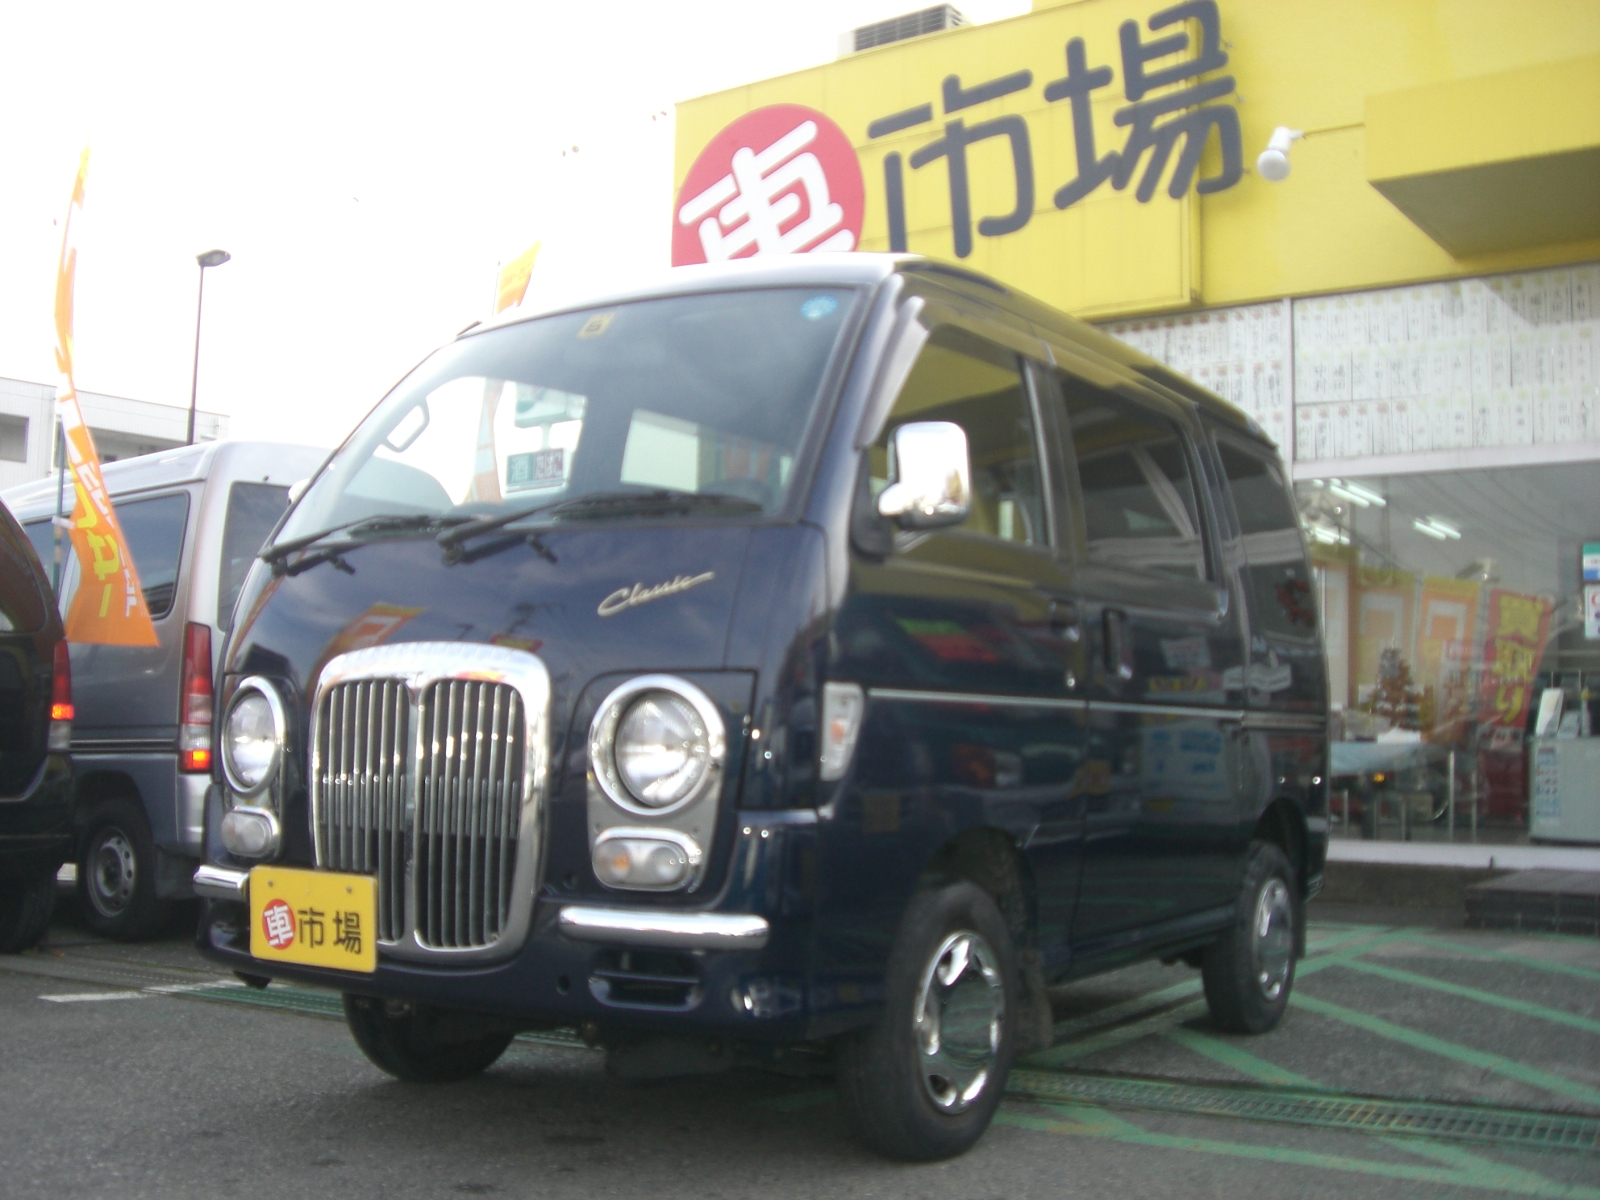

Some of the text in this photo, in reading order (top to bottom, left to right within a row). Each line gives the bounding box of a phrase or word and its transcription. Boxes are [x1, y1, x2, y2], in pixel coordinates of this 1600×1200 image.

[679, 0, 1242, 262] 車市場
[597, 571, 715, 617] Classic
[263, 905, 362, 955] 車市場
